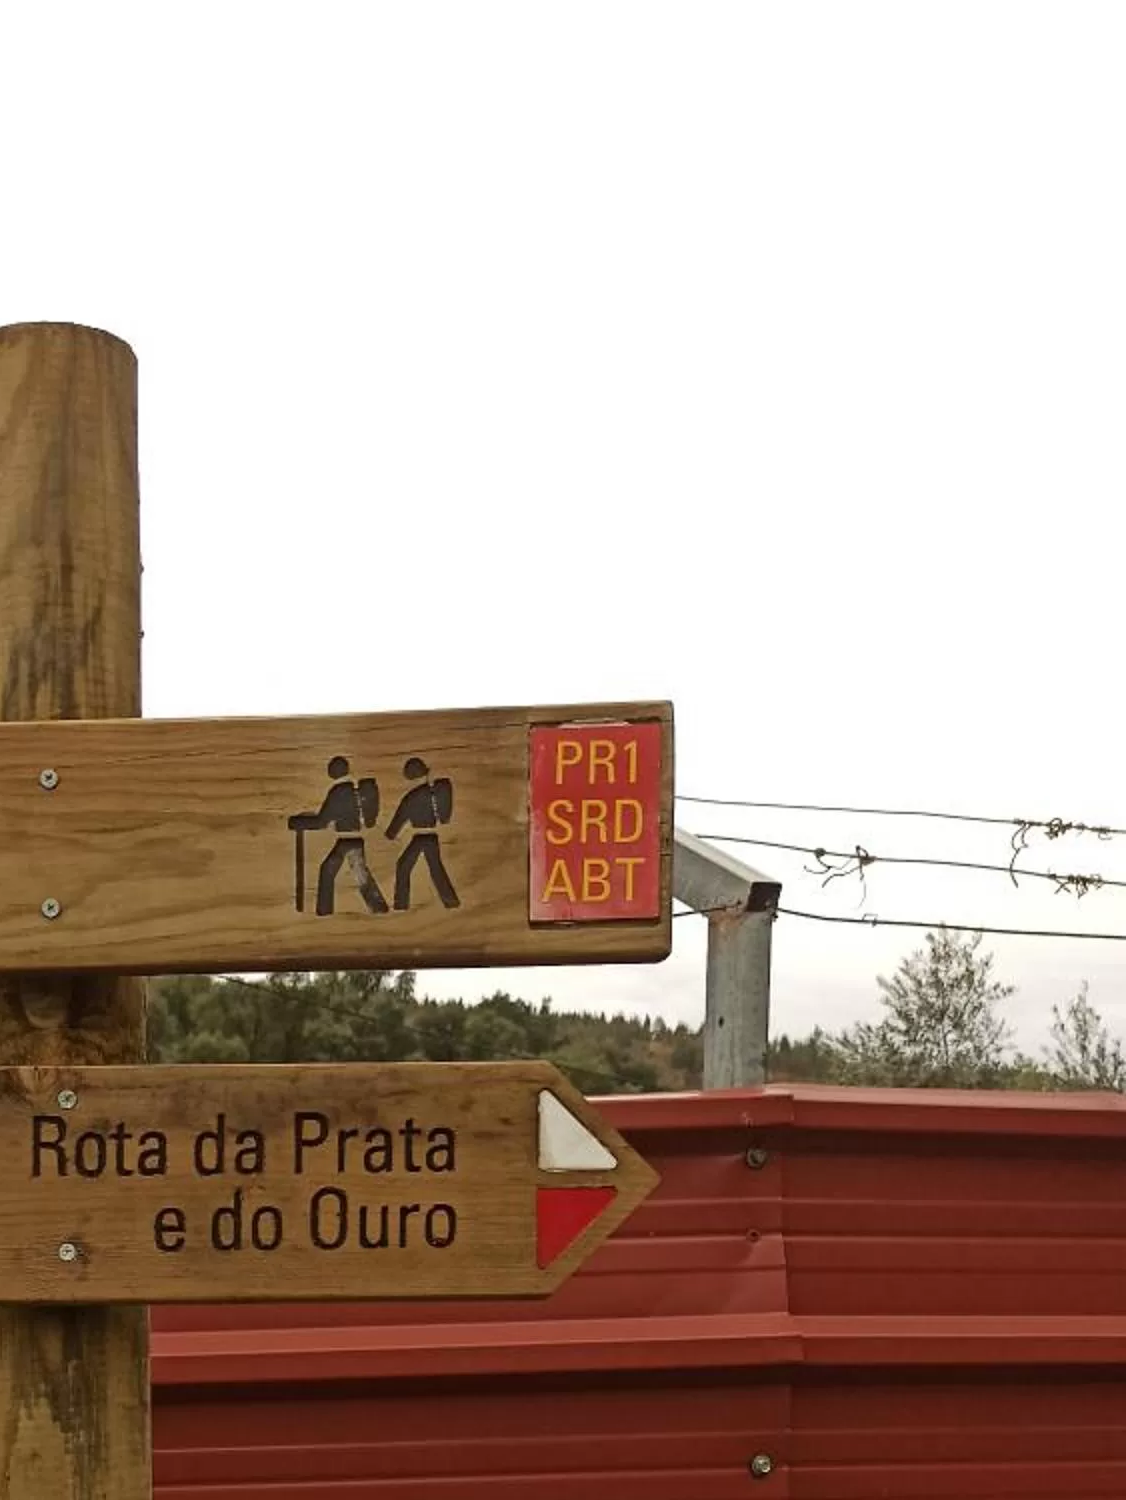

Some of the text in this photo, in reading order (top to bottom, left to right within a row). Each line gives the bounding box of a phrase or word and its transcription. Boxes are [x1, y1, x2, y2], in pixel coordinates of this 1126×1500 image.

[554, 739, 638, 785] PR1
[545, 798, 644, 845] SRD
[541, 856, 647, 903] ABT
[31, 1111, 457, 1178] Rota da Prata
[153, 1185, 458, 1253] e do Ouro
